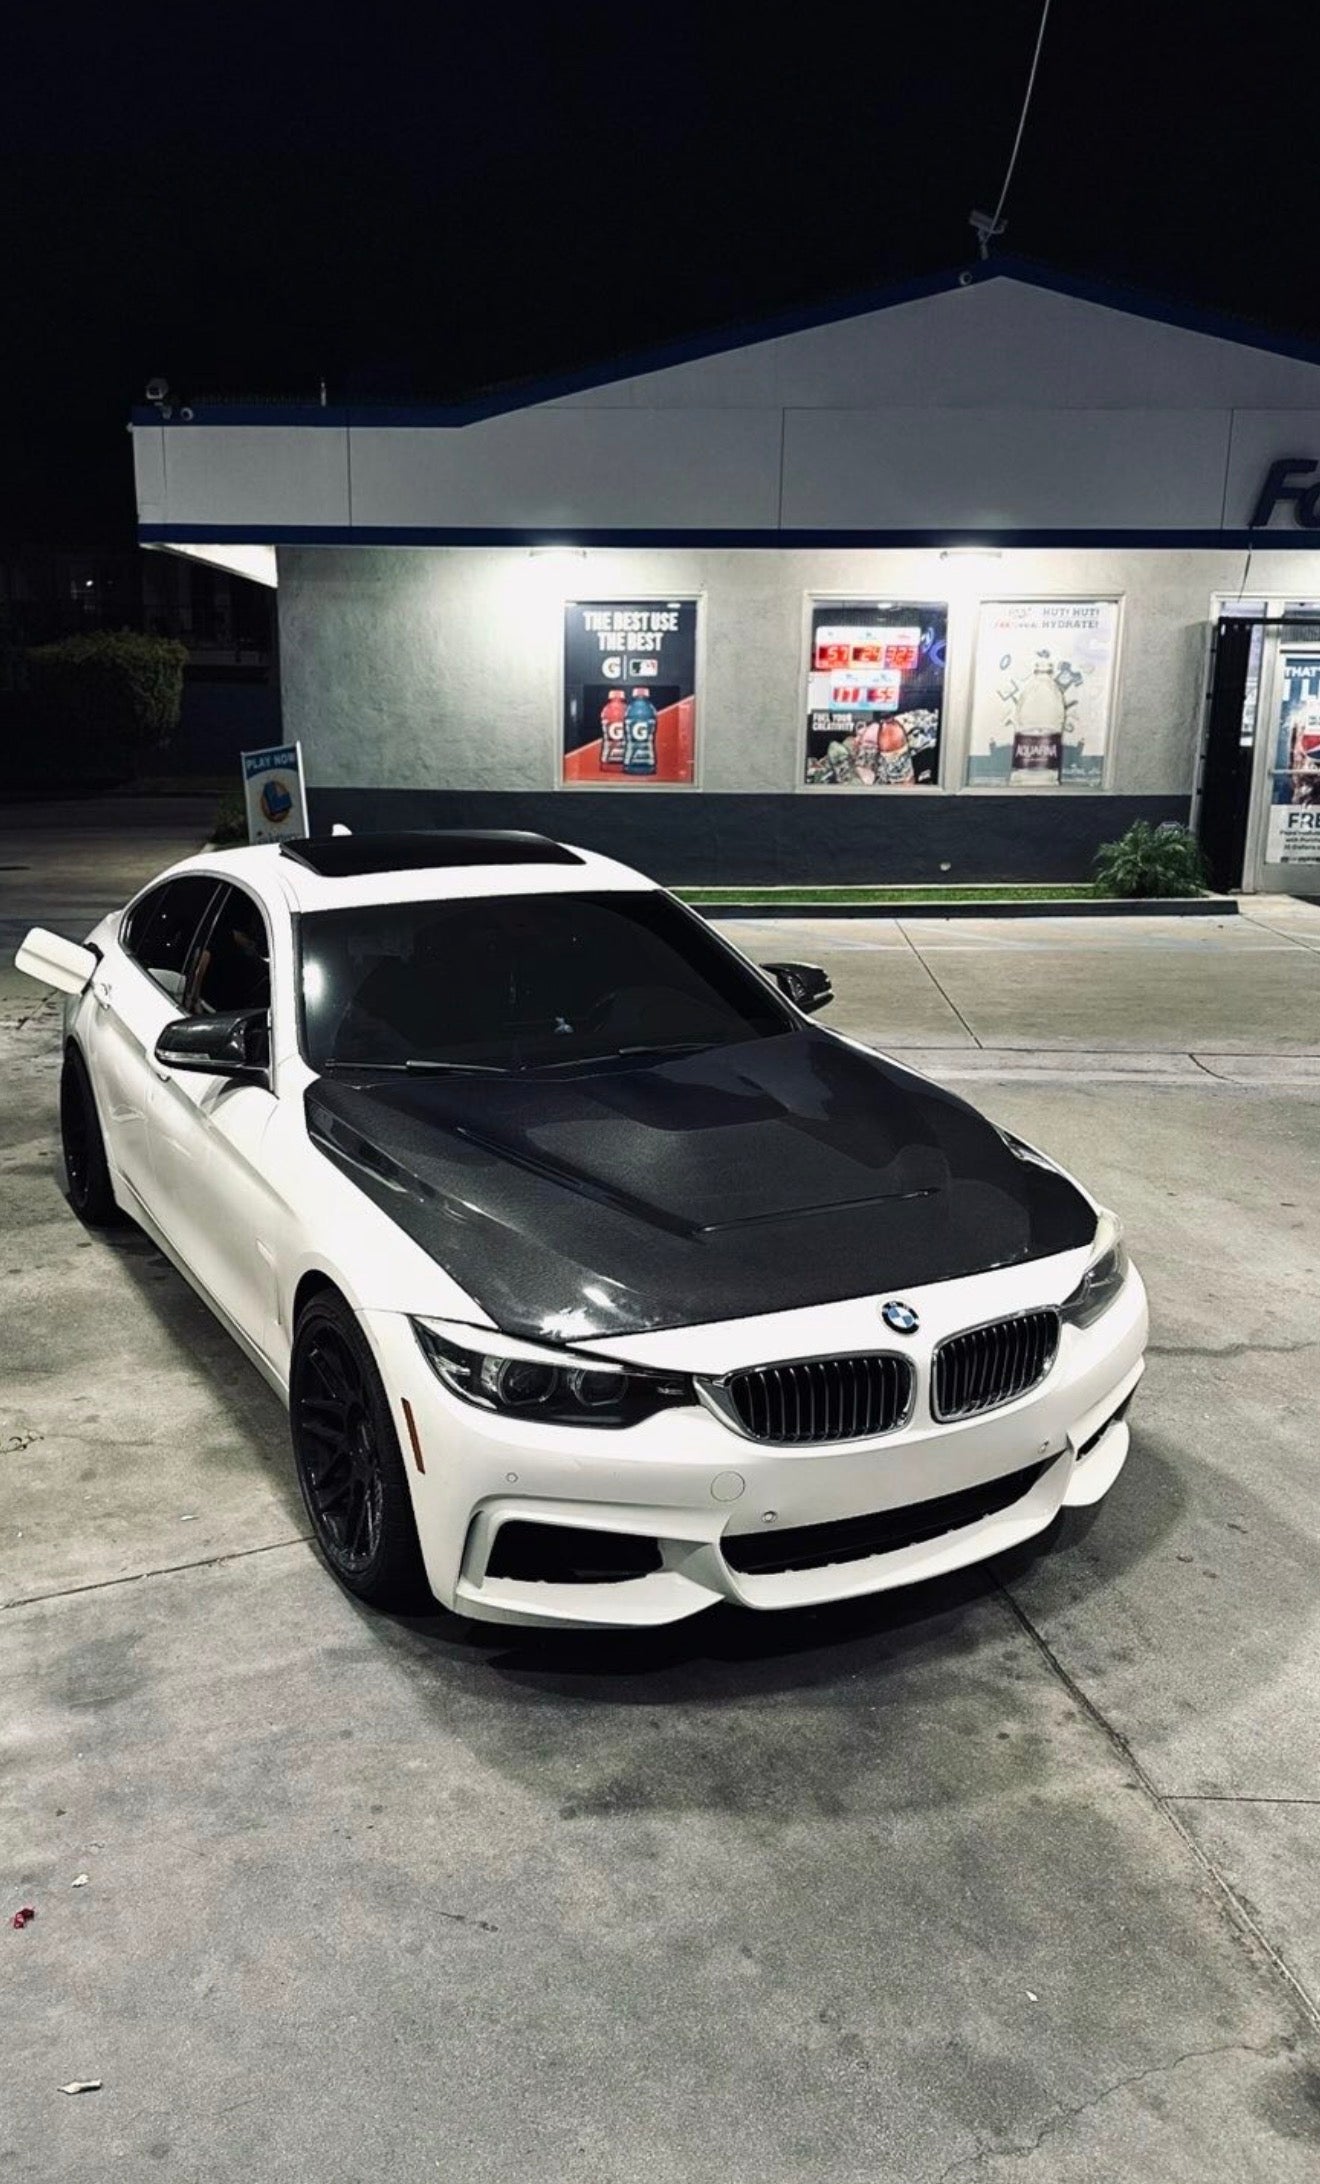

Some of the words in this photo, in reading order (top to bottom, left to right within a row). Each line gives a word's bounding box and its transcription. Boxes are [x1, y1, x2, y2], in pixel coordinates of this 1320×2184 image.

[1043, 608, 1069, 616] HUT!
[1072, 607, 1100, 616] HUT!
[582, 611, 612, 632] THE
[613, 611, 649, 632] BEST
[650, 612, 679, 632] USE
[1041, 619, 1099, 629] HYDRATE!
[597, 632, 626, 651] THE
[626, 632, 664, 651] BEST
[602, 656, 622, 679] G
[609, 723, 625, 740] G
[632, 722, 649, 740] G
[246, 755, 272, 770] PLAY
[273, 752, 296, 766] NOW
